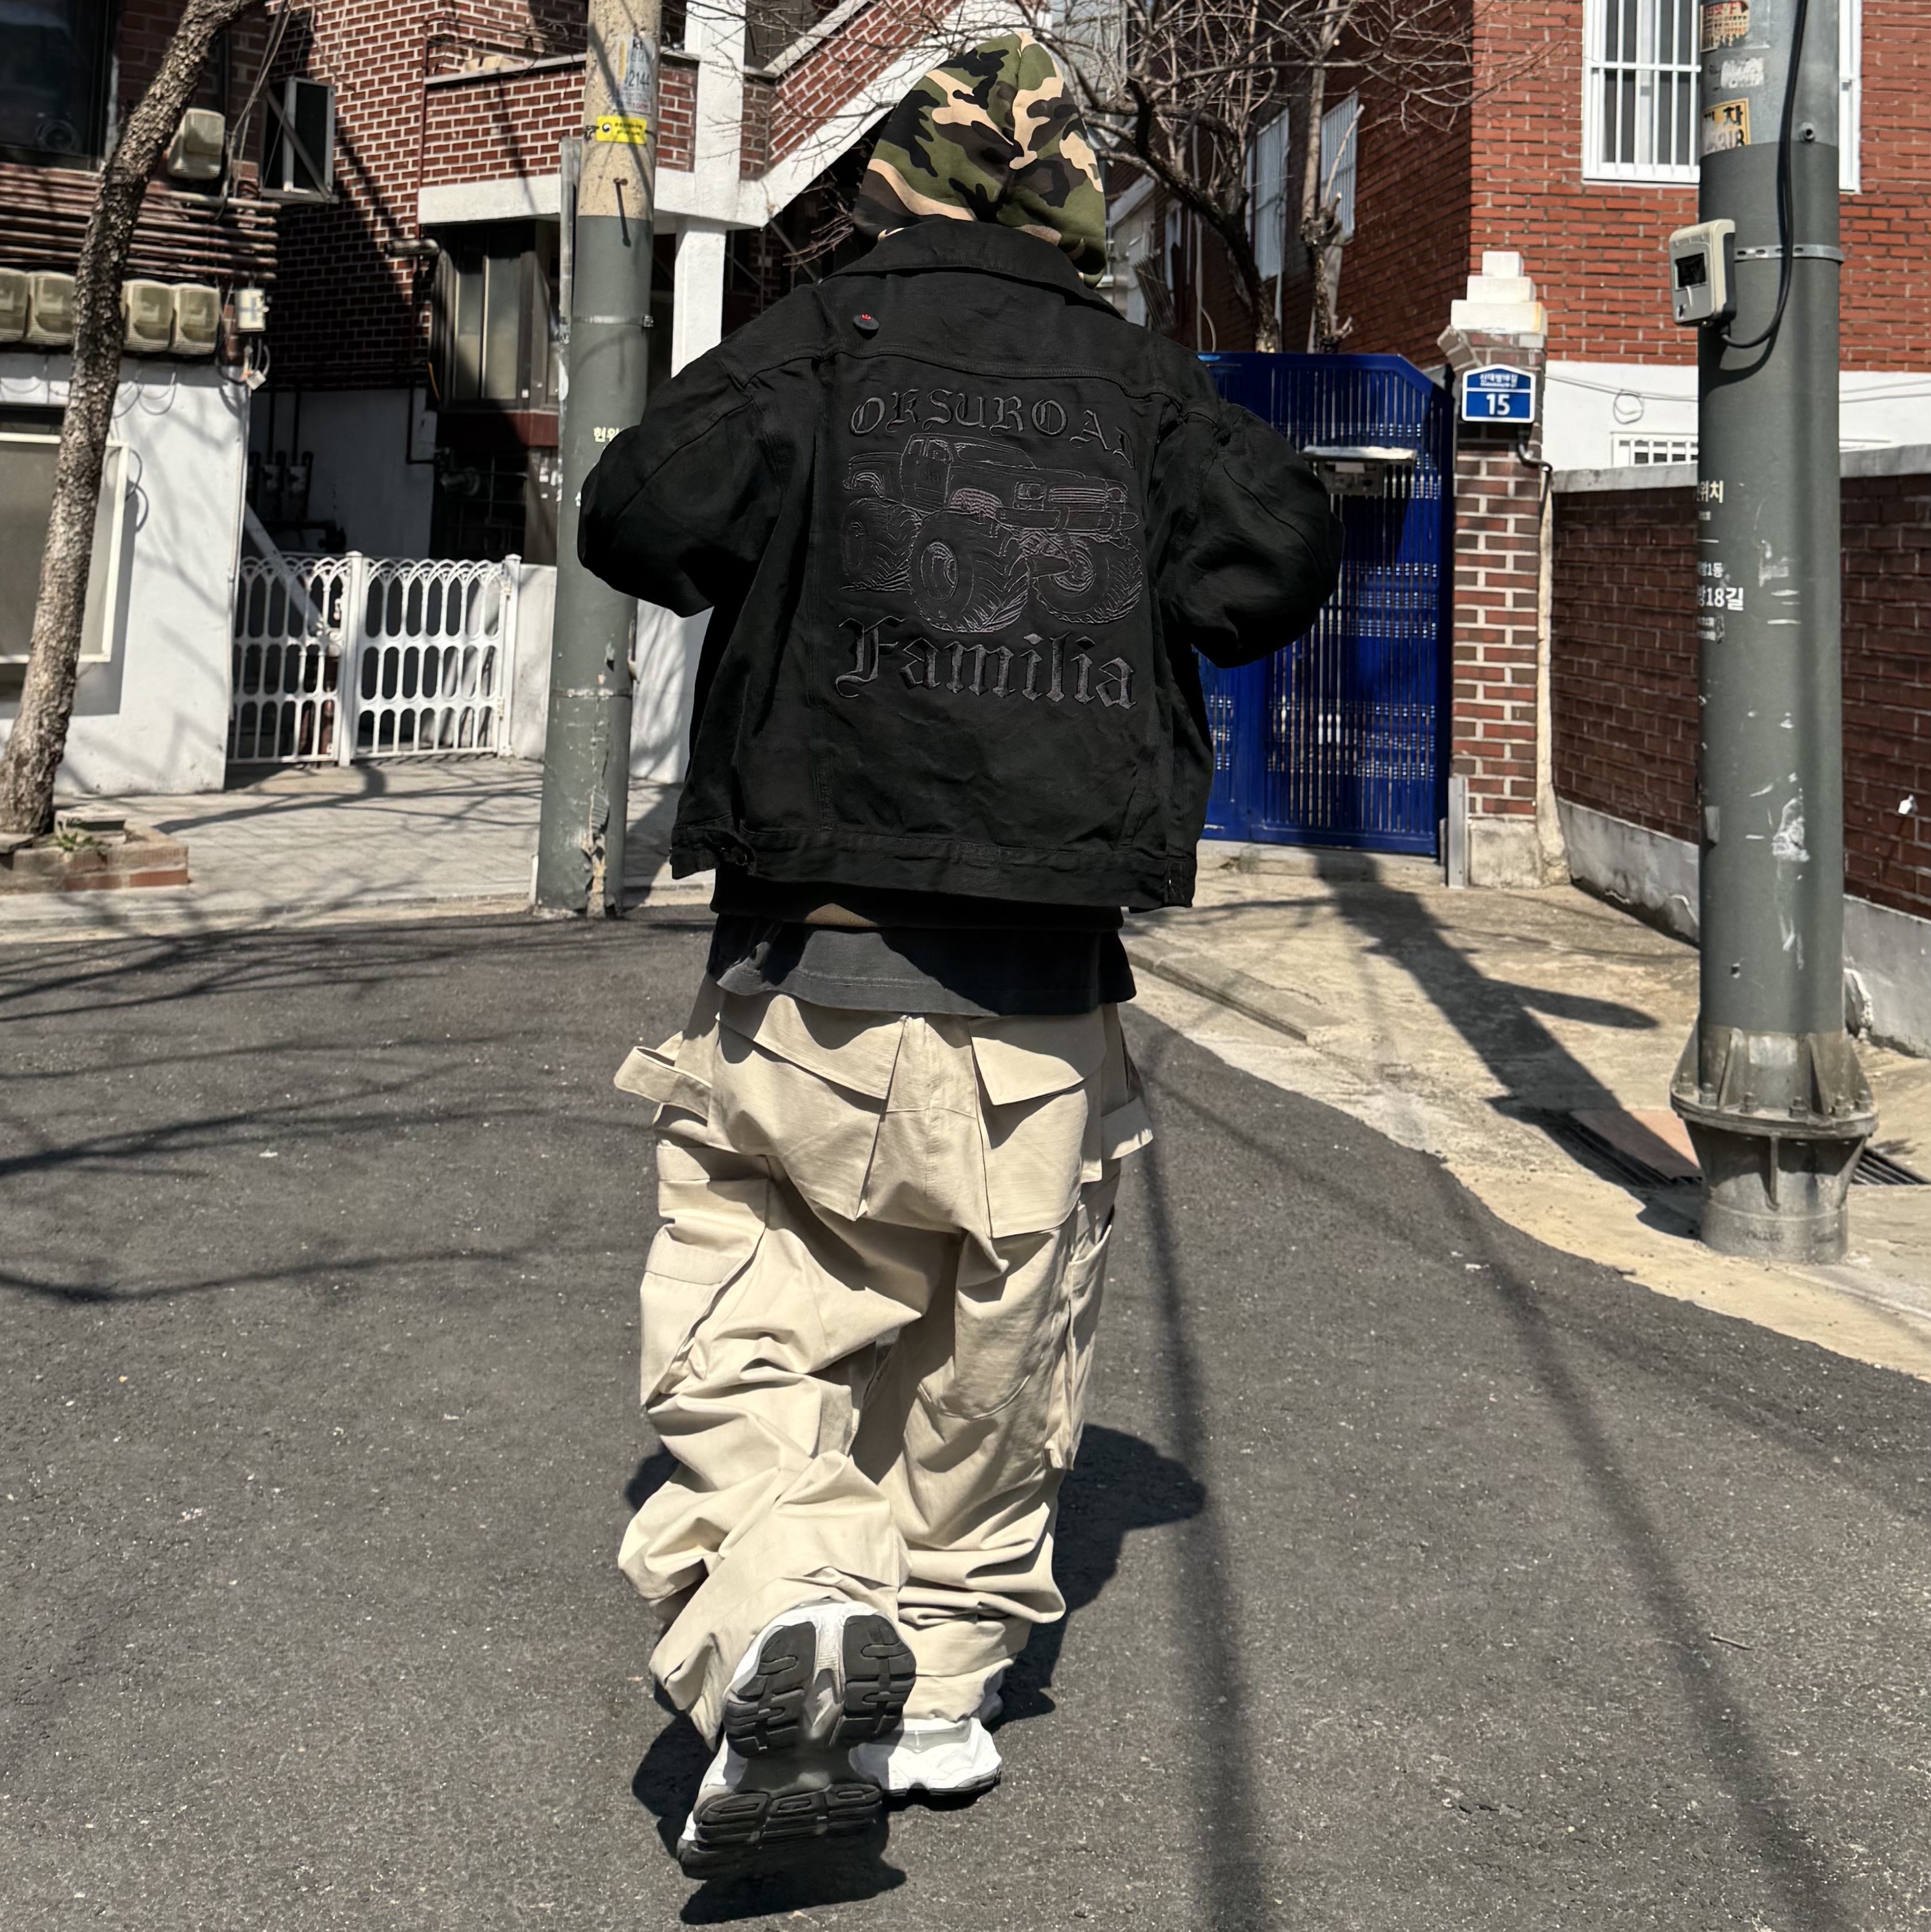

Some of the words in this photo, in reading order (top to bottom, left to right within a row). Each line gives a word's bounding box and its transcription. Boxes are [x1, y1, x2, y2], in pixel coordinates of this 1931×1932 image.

[1486, 393, 1511, 415] 15
[593, 427, 620, 443] 현위
[1697, 480, 1724, 503] 위치
[836, 615, 1137, 709] Familia
